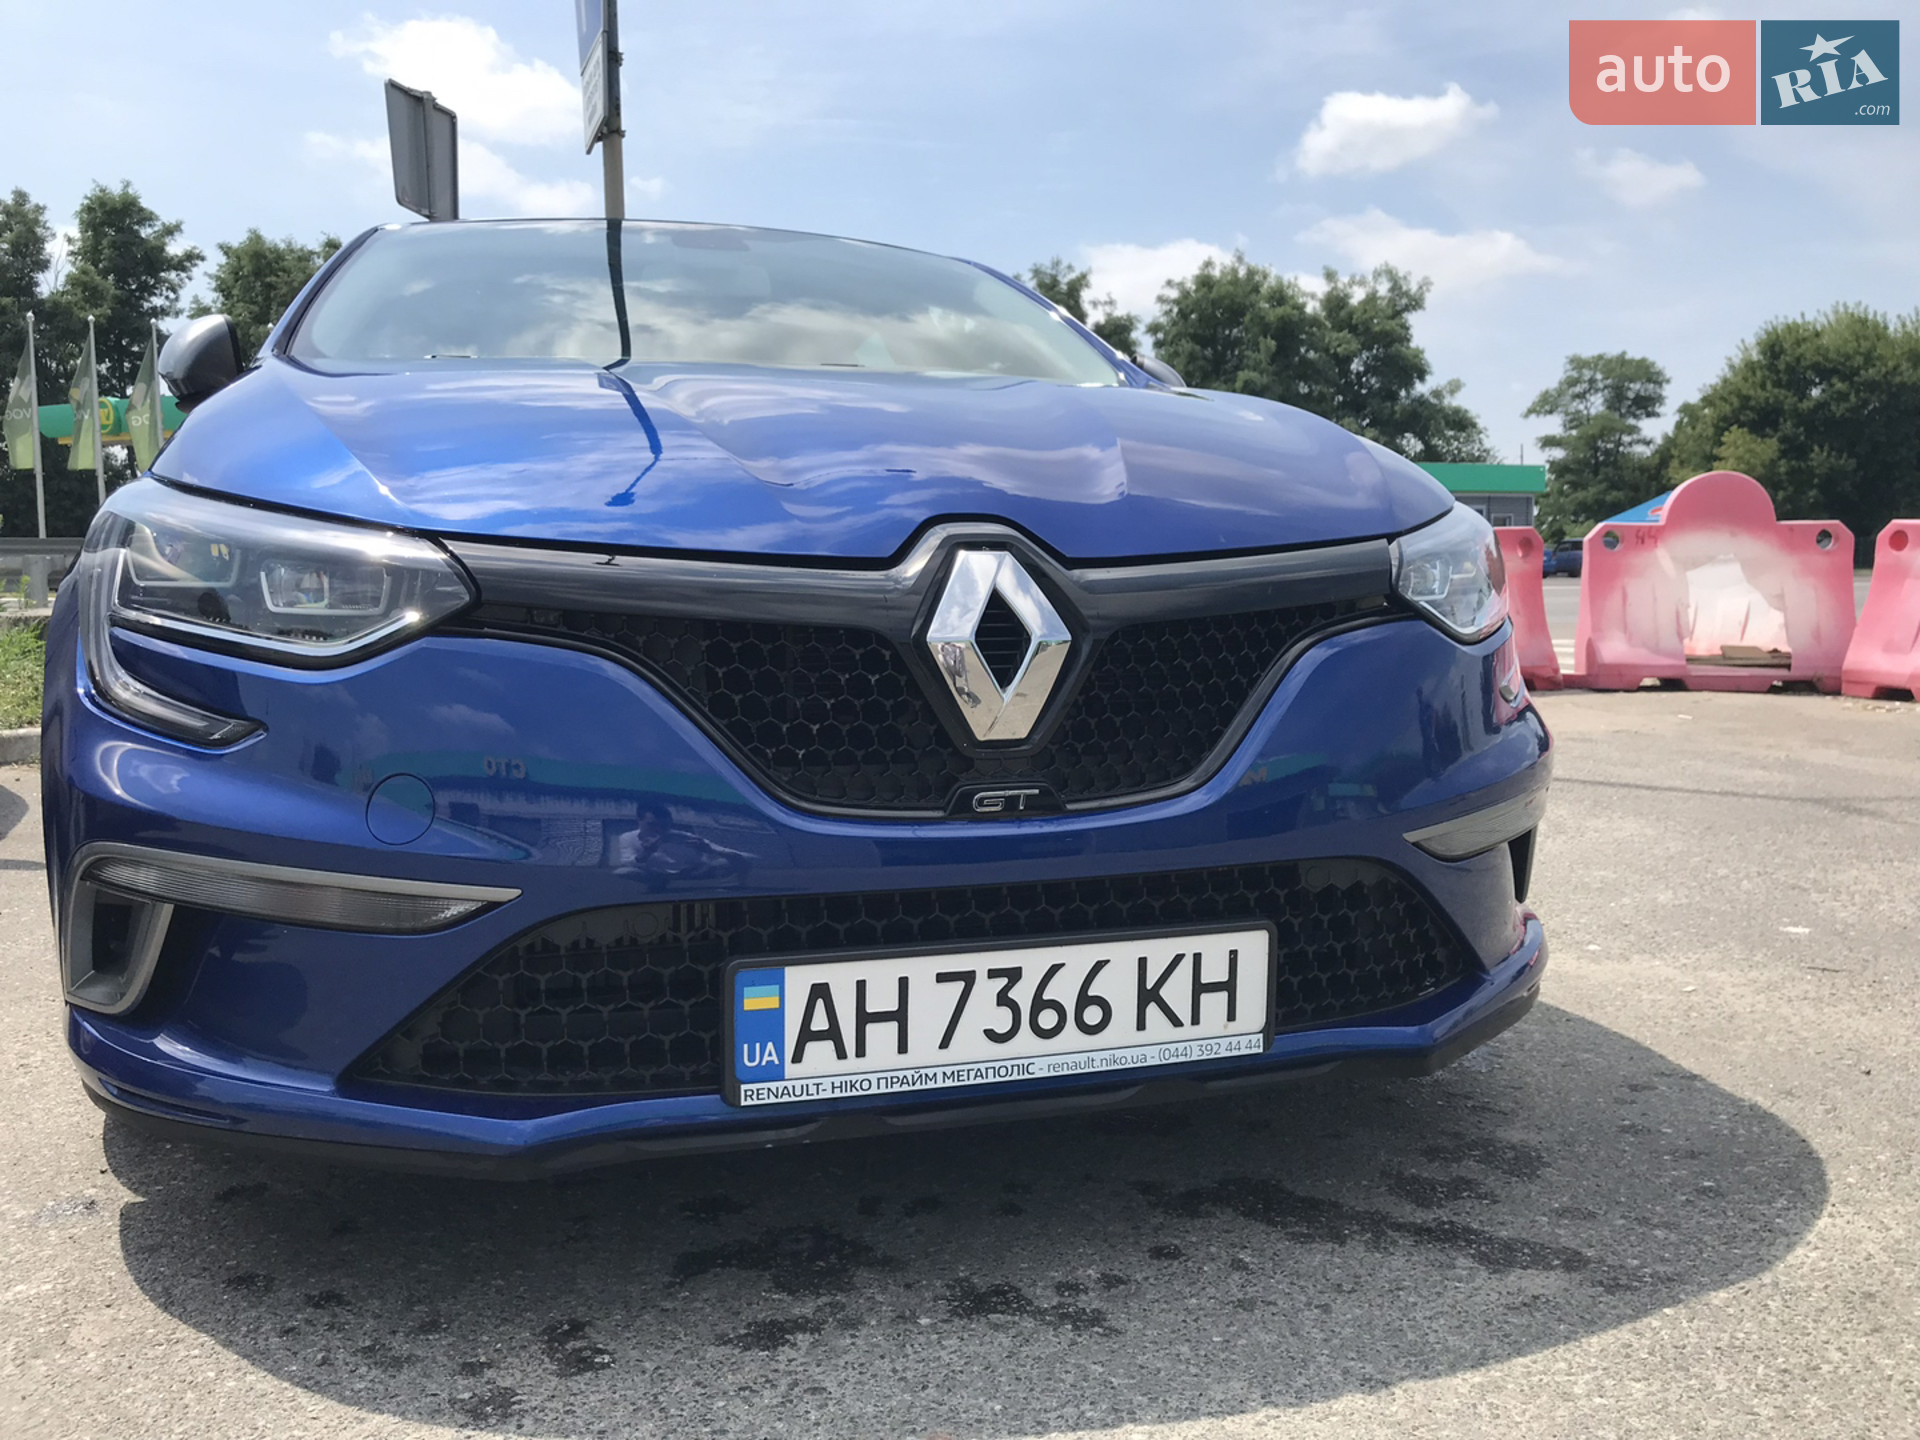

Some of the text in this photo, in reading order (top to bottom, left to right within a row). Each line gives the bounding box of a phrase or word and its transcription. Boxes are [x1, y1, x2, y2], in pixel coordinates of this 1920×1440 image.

[973, 789, 1039, 812] GT
[791, 949, 1238, 1064] AH 7366 KH
[743, 1042, 779, 1067] UA
[831, 1078, 872, 1095] НІКО
[877, 1069, 938, 1090] ПРАЙМ
[942, 1062, 1035, 1084] МЕГАПОЛІС
[1047, 1053, 1147, 1073] renault.niko.ua
[1158, 1045, 1193, 1062] (044)
[1197, 1042, 1221, 1057] 392
[1225, 1041, 1241, 1053] 44
[1245, 1038, 1261, 1050] 44
